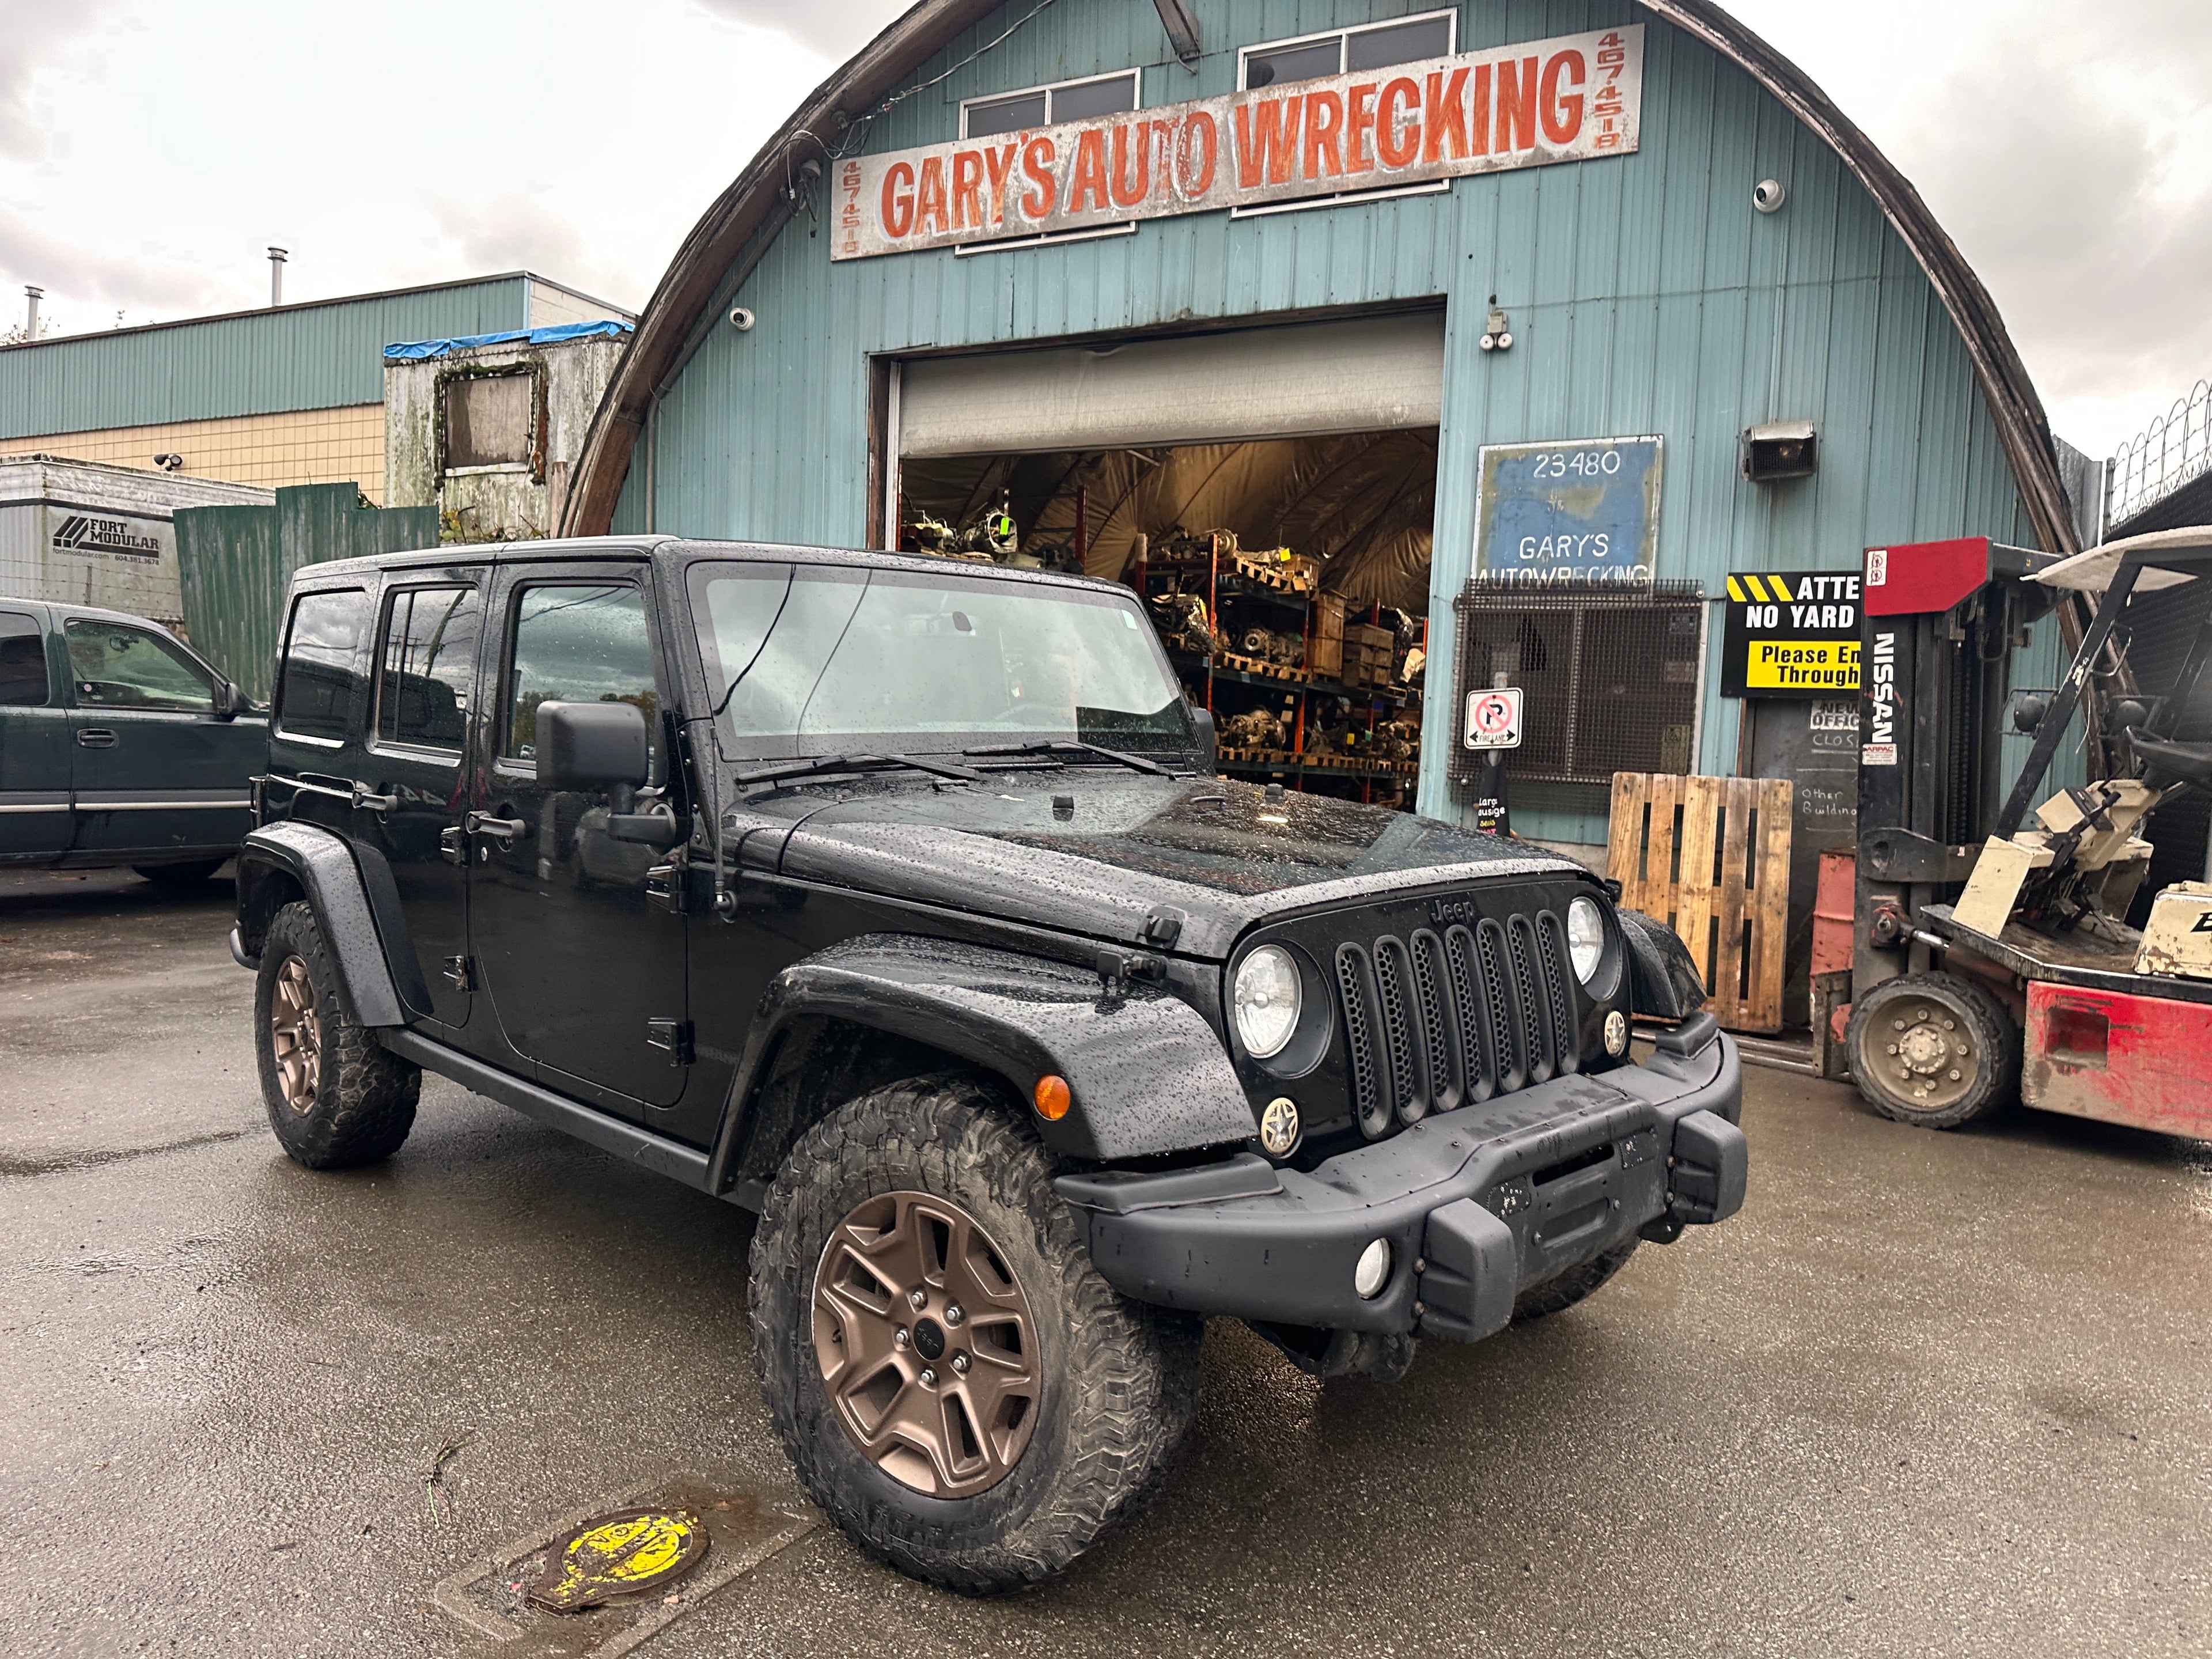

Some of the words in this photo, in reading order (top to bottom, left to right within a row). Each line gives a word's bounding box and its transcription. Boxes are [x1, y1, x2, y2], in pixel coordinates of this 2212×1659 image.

[880, 132, 1055, 239] GARY'S
[1068, 110, 1218, 213] AUTO
[1234, 49, 1586, 188] WRECKING
[1533, 450, 1621, 479] 23480
[90, 518, 127, 534] FORT
[90, 531, 160, 550] MODULAR
[1519, 533, 1609, 560] GARY'S
[52, 547, 109, 560] fortmodular.com
[115, 554, 160, 566] 604.381.3678
[1796, 575, 1860, 600] ATTE
[1745, 605, 1779, 628] NO
[1790, 605, 1854, 628] YARD
[1761, 645, 1828, 664] Please
[1838, 645, 1861, 664] En
[1777, 665, 1858, 687] Through
[1872, 632, 1895, 743] NISSAN
[1479, 734, 1491, 743] FIRE
[1812, 733, 1859, 749] CLOS
[1801, 787, 1844, 801] Other
[1430, 899, 1475, 925] Jeep
